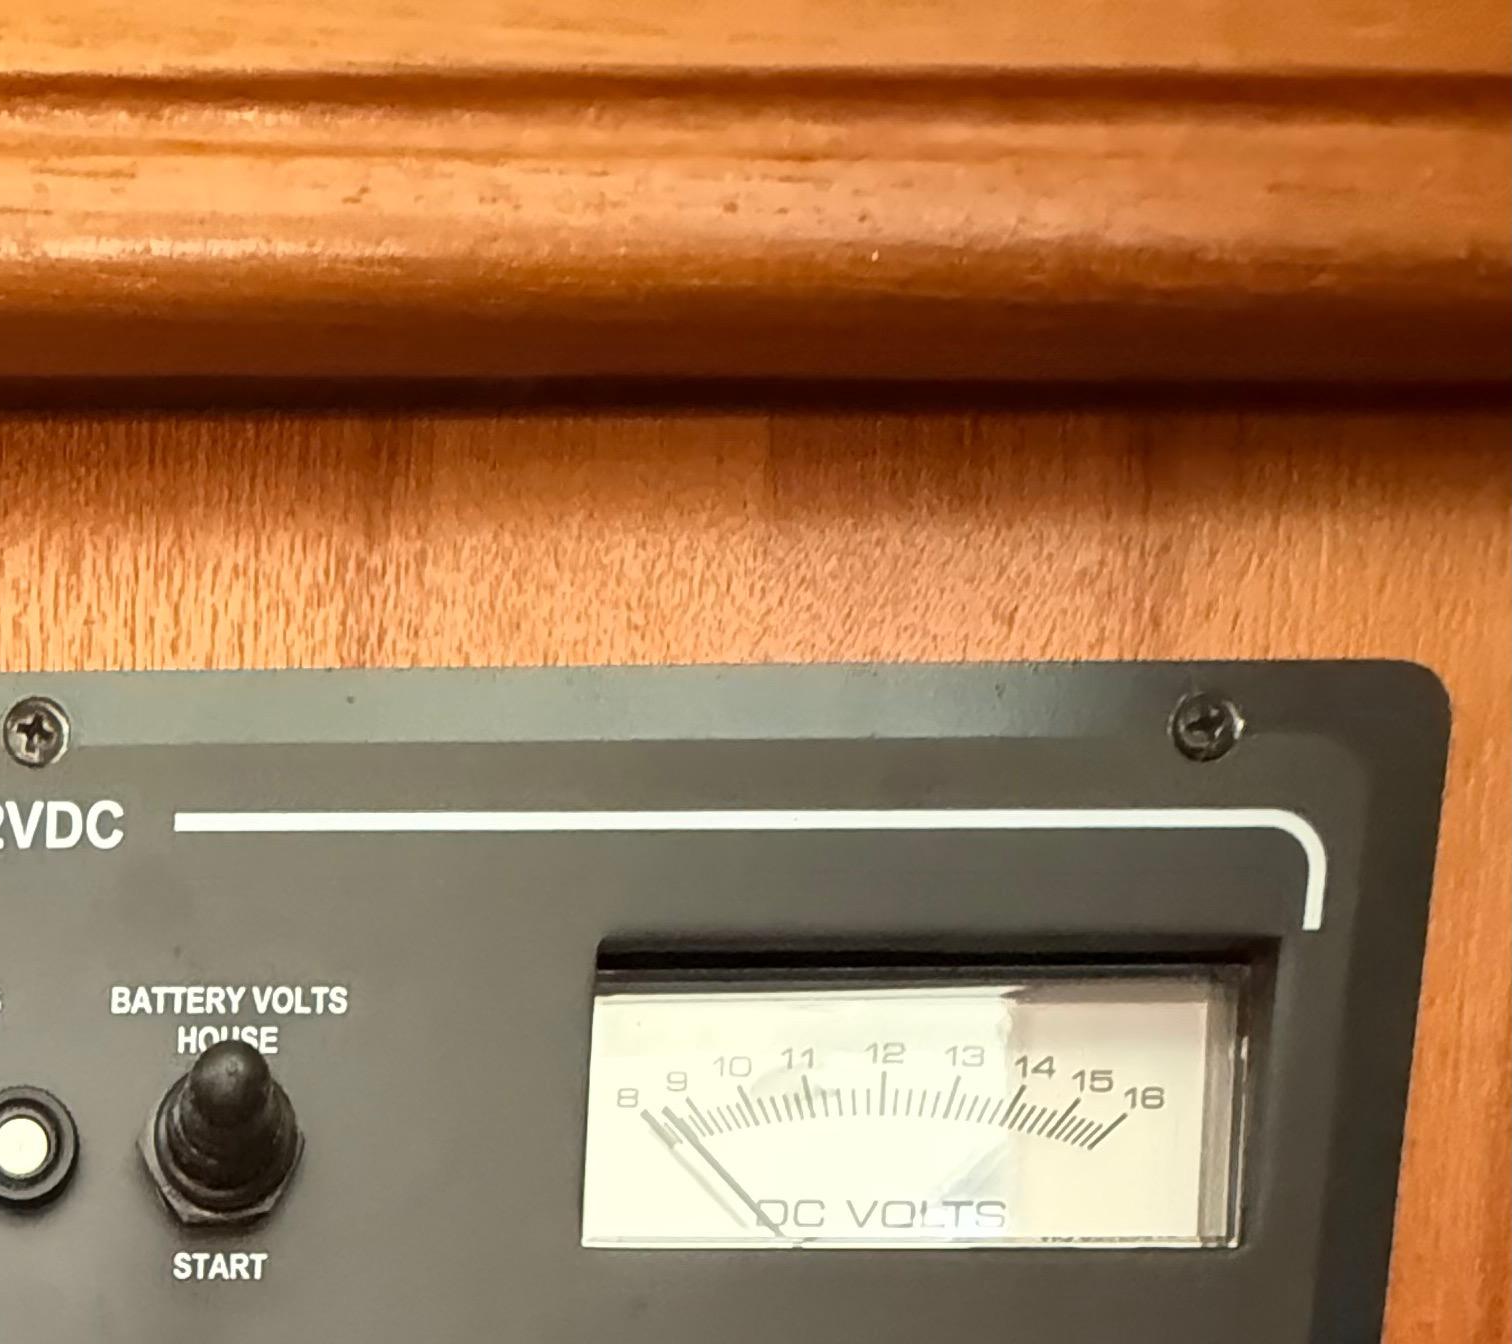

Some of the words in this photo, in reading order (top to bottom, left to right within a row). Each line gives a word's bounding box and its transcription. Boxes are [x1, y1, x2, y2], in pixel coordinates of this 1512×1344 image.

[110, 986, 246, 1015] BATTERY
[252, 985, 348, 1015] VOLTS
[616, 1088, 639, 1108] 8
[666, 1071, 688, 1092] 9
[713, 1056, 752, 1077] 10
[780, 1048, 815, 1068] 11
[865, 1043, 906, 1064] 12
[944, 1045, 985, 1068] 13
[1014, 1057, 1055, 1079] 14
[1071, 1070, 1113, 1093] 15
[1123, 1087, 1165, 1110] 16
[755, 1201, 825, 1227] DC
[845, 1201, 1008, 1228] VOLTS
[173, 1252, 268, 1280] START
